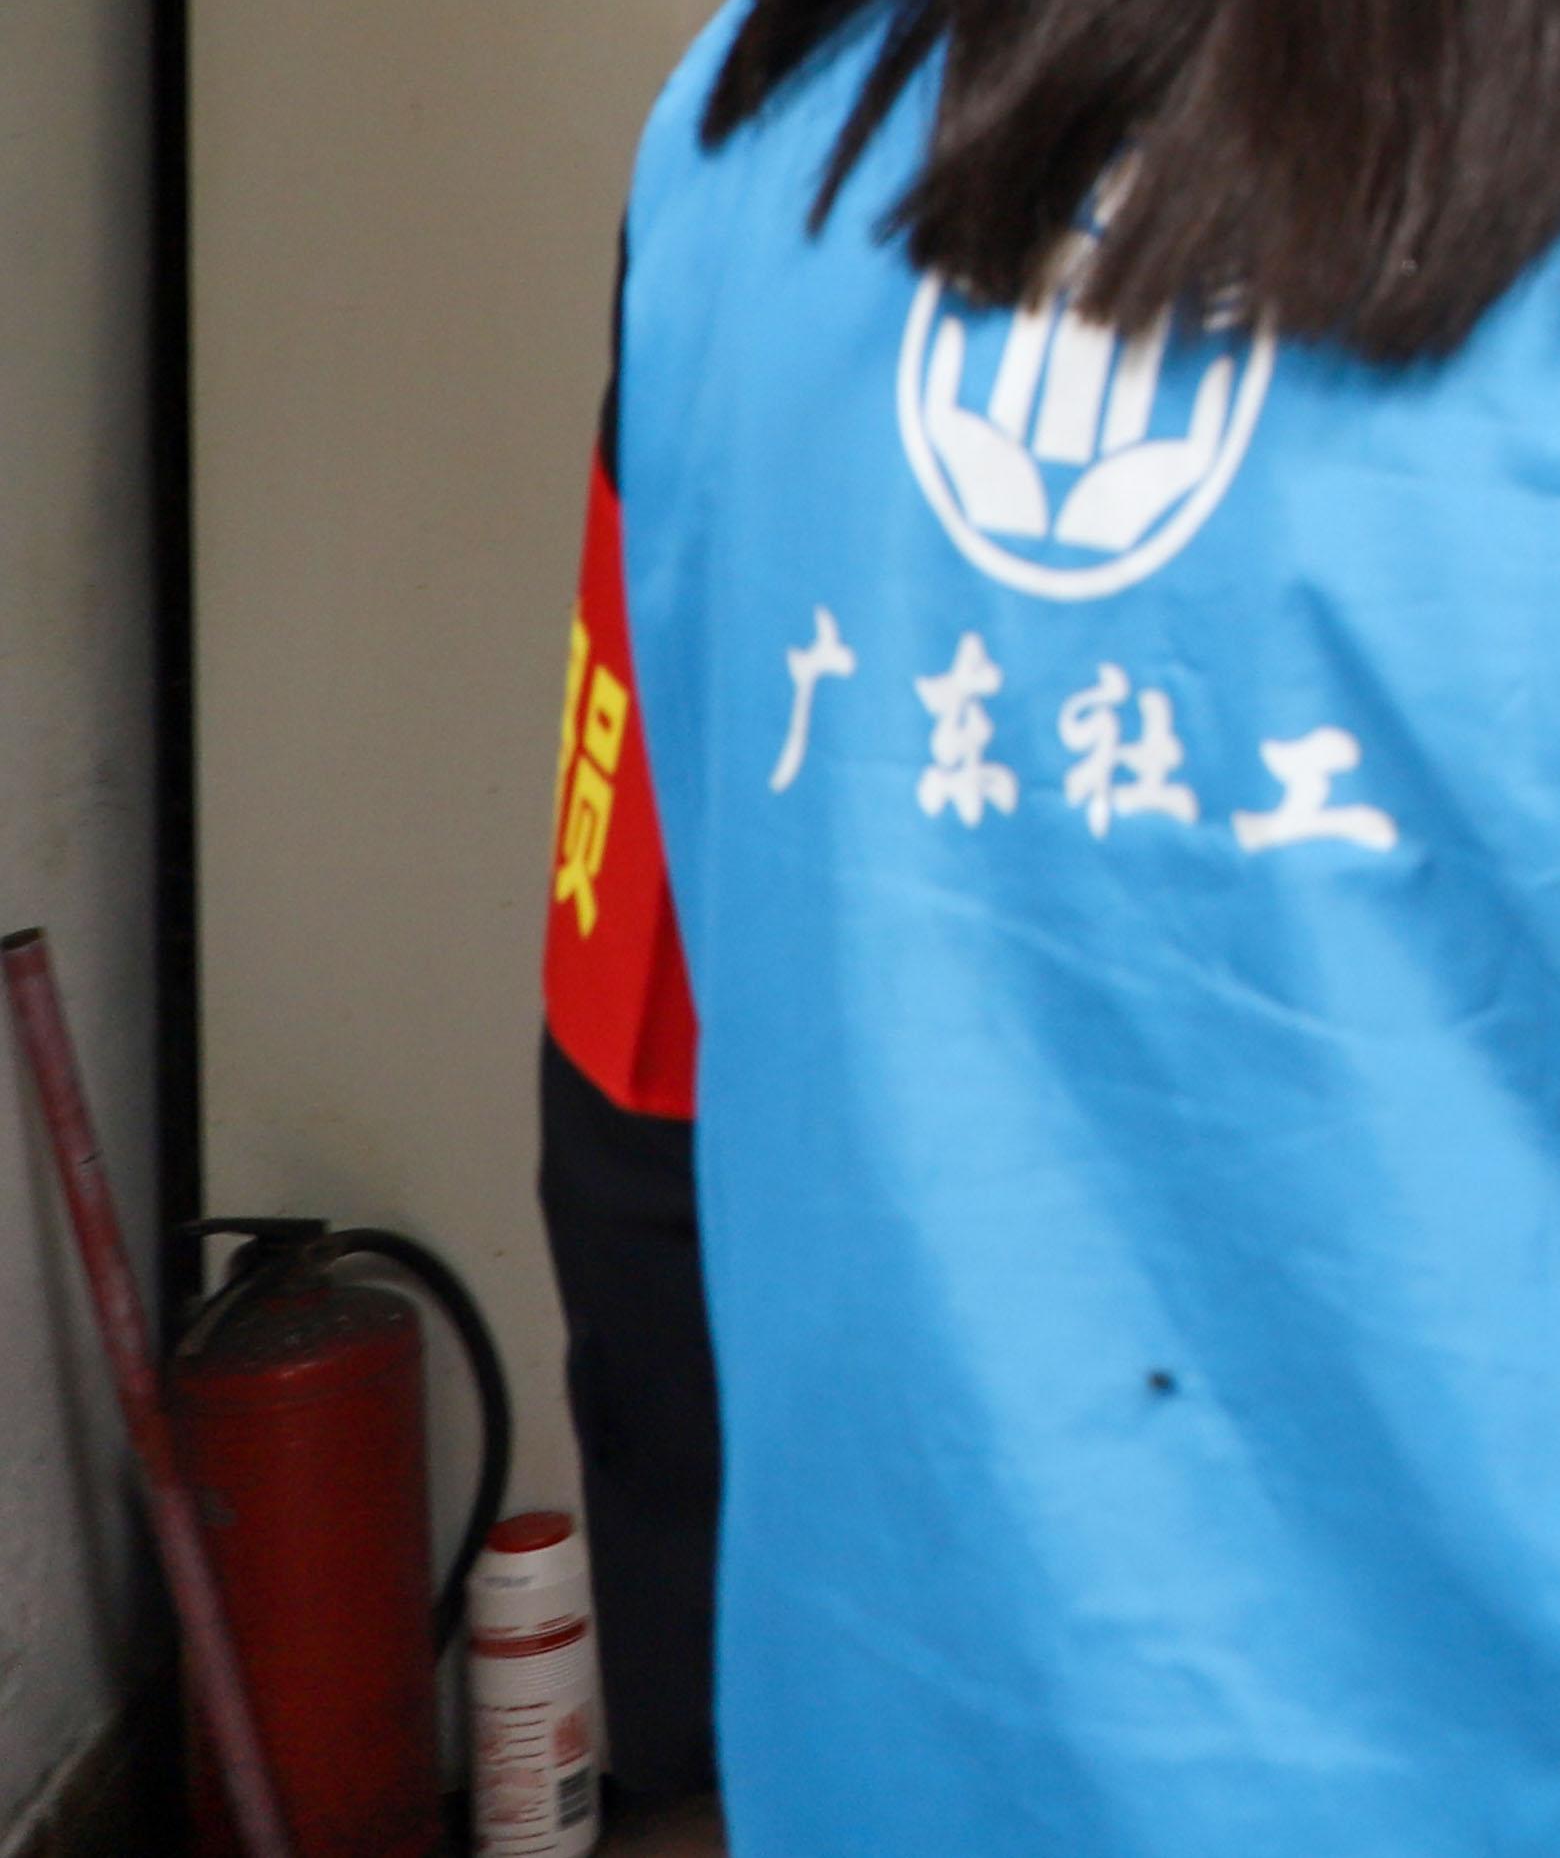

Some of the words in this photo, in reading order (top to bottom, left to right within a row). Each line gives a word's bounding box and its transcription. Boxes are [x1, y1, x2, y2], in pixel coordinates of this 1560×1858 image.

[553, 602, 629, 940] 员
[768, 603, 1399, 853] 广东社工
